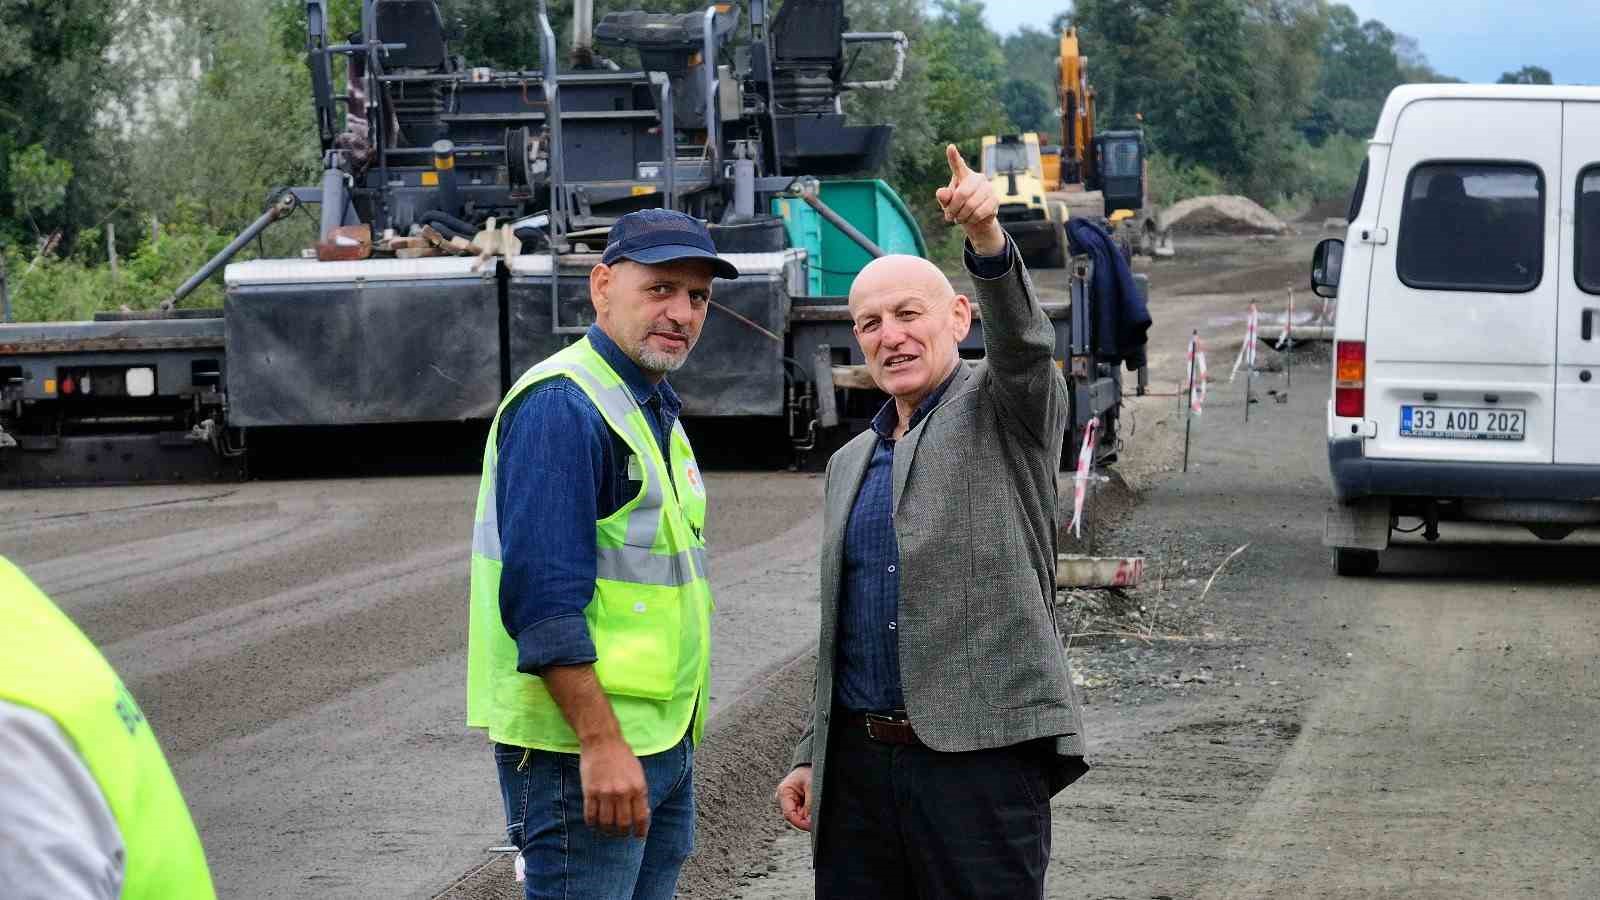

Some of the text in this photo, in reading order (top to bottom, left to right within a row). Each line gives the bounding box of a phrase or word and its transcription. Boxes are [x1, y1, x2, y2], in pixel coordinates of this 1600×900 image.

[1414, 410, 1436, 429] 33
[1446, 412, 1479, 431] AOD
[1487, 413, 1521, 432] 202
